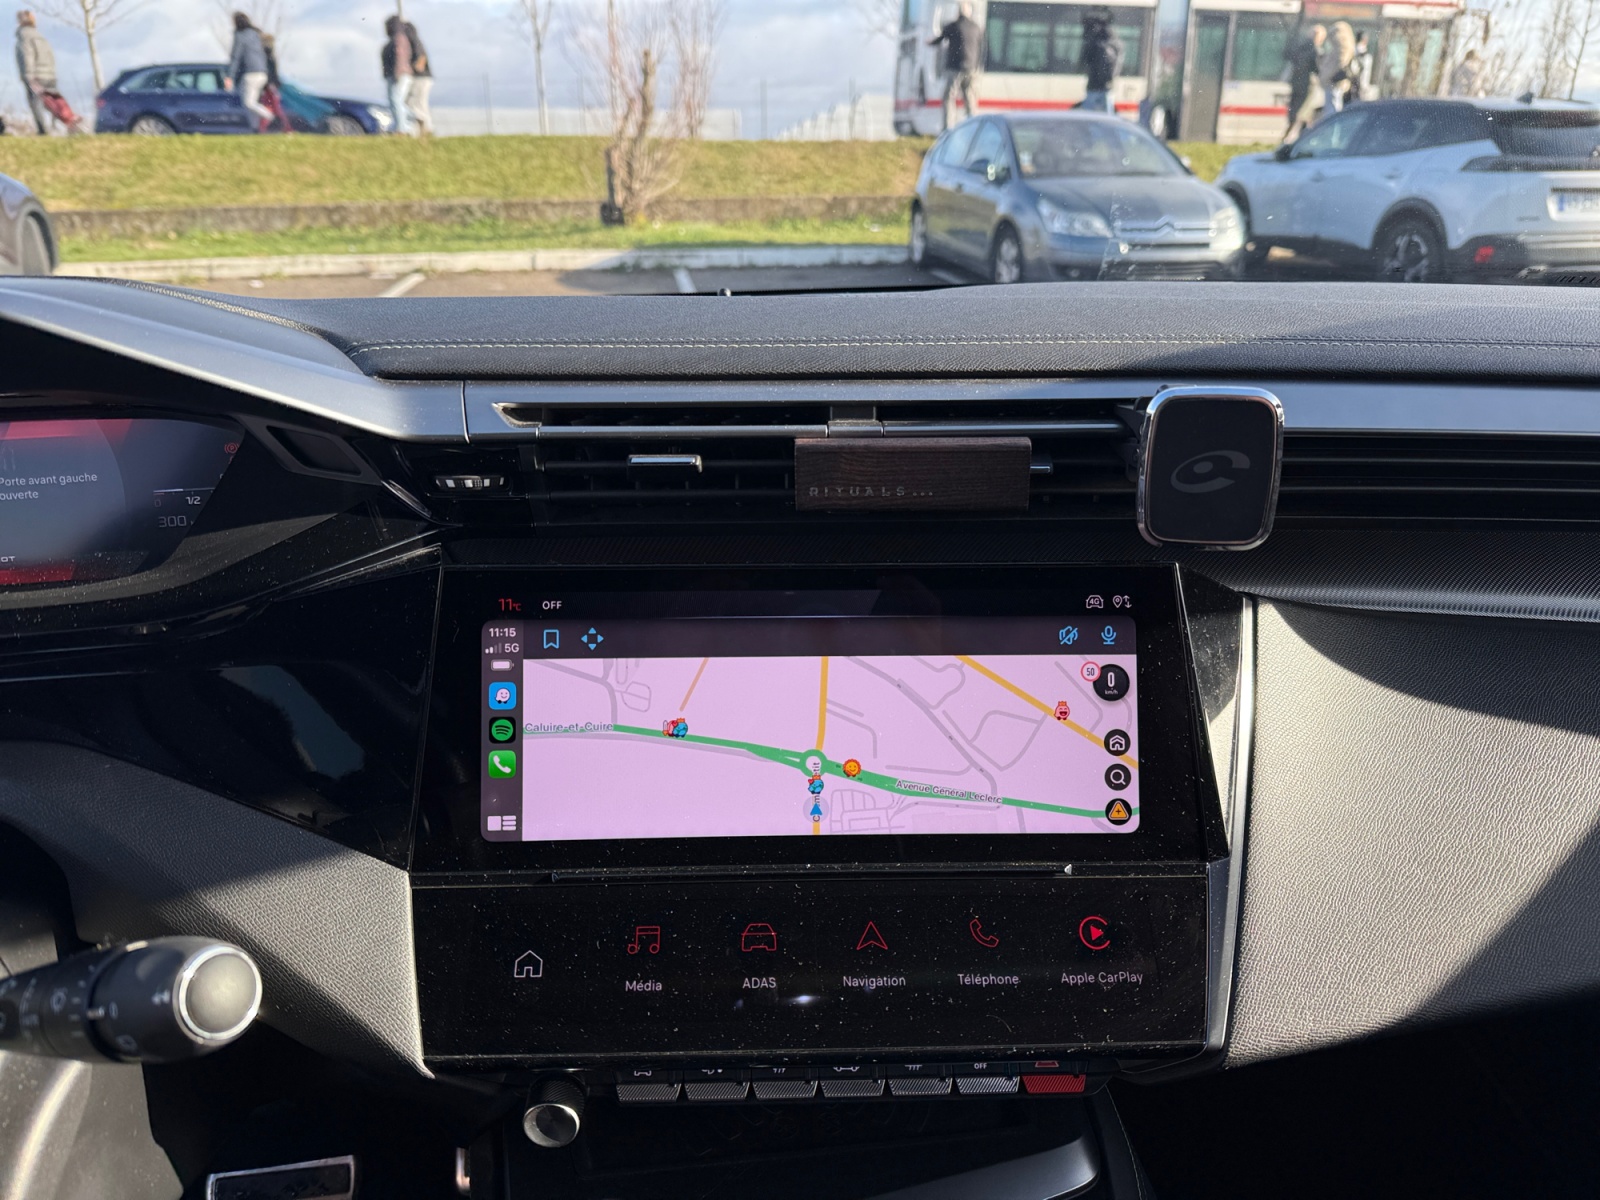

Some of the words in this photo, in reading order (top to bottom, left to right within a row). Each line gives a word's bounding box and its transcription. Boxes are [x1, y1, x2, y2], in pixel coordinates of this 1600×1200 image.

[28, 475, 57, 485] avant
[59, 473, 98, 485] gauche
[0, 490, 39, 500] ouverte
[158, 515, 187, 527] 300
[542, 600, 562, 610] OFF
[488, 627, 517, 638] 11:15
[504, 642, 520, 653] 5G
[1086, 667, 1095, 676] 50
[1107, 672, 1115, 687] 0
[524, 721, 613, 732] Caluire-et-Cuire
[895, 780, 931, 793] Avenue
[968, 791, 1002, 804] Leclerc
[742, 977, 777, 989] ADAS
[842, 975, 907, 989] Navigation
[957, 973, 1019, 987] Téléphone
[1060, 971, 1096, 986] Apple
[1098, 970, 1144, 985] CarPlay
[625, 980, 663, 992] Média
[973, 1062, 988, 1070] OFF
